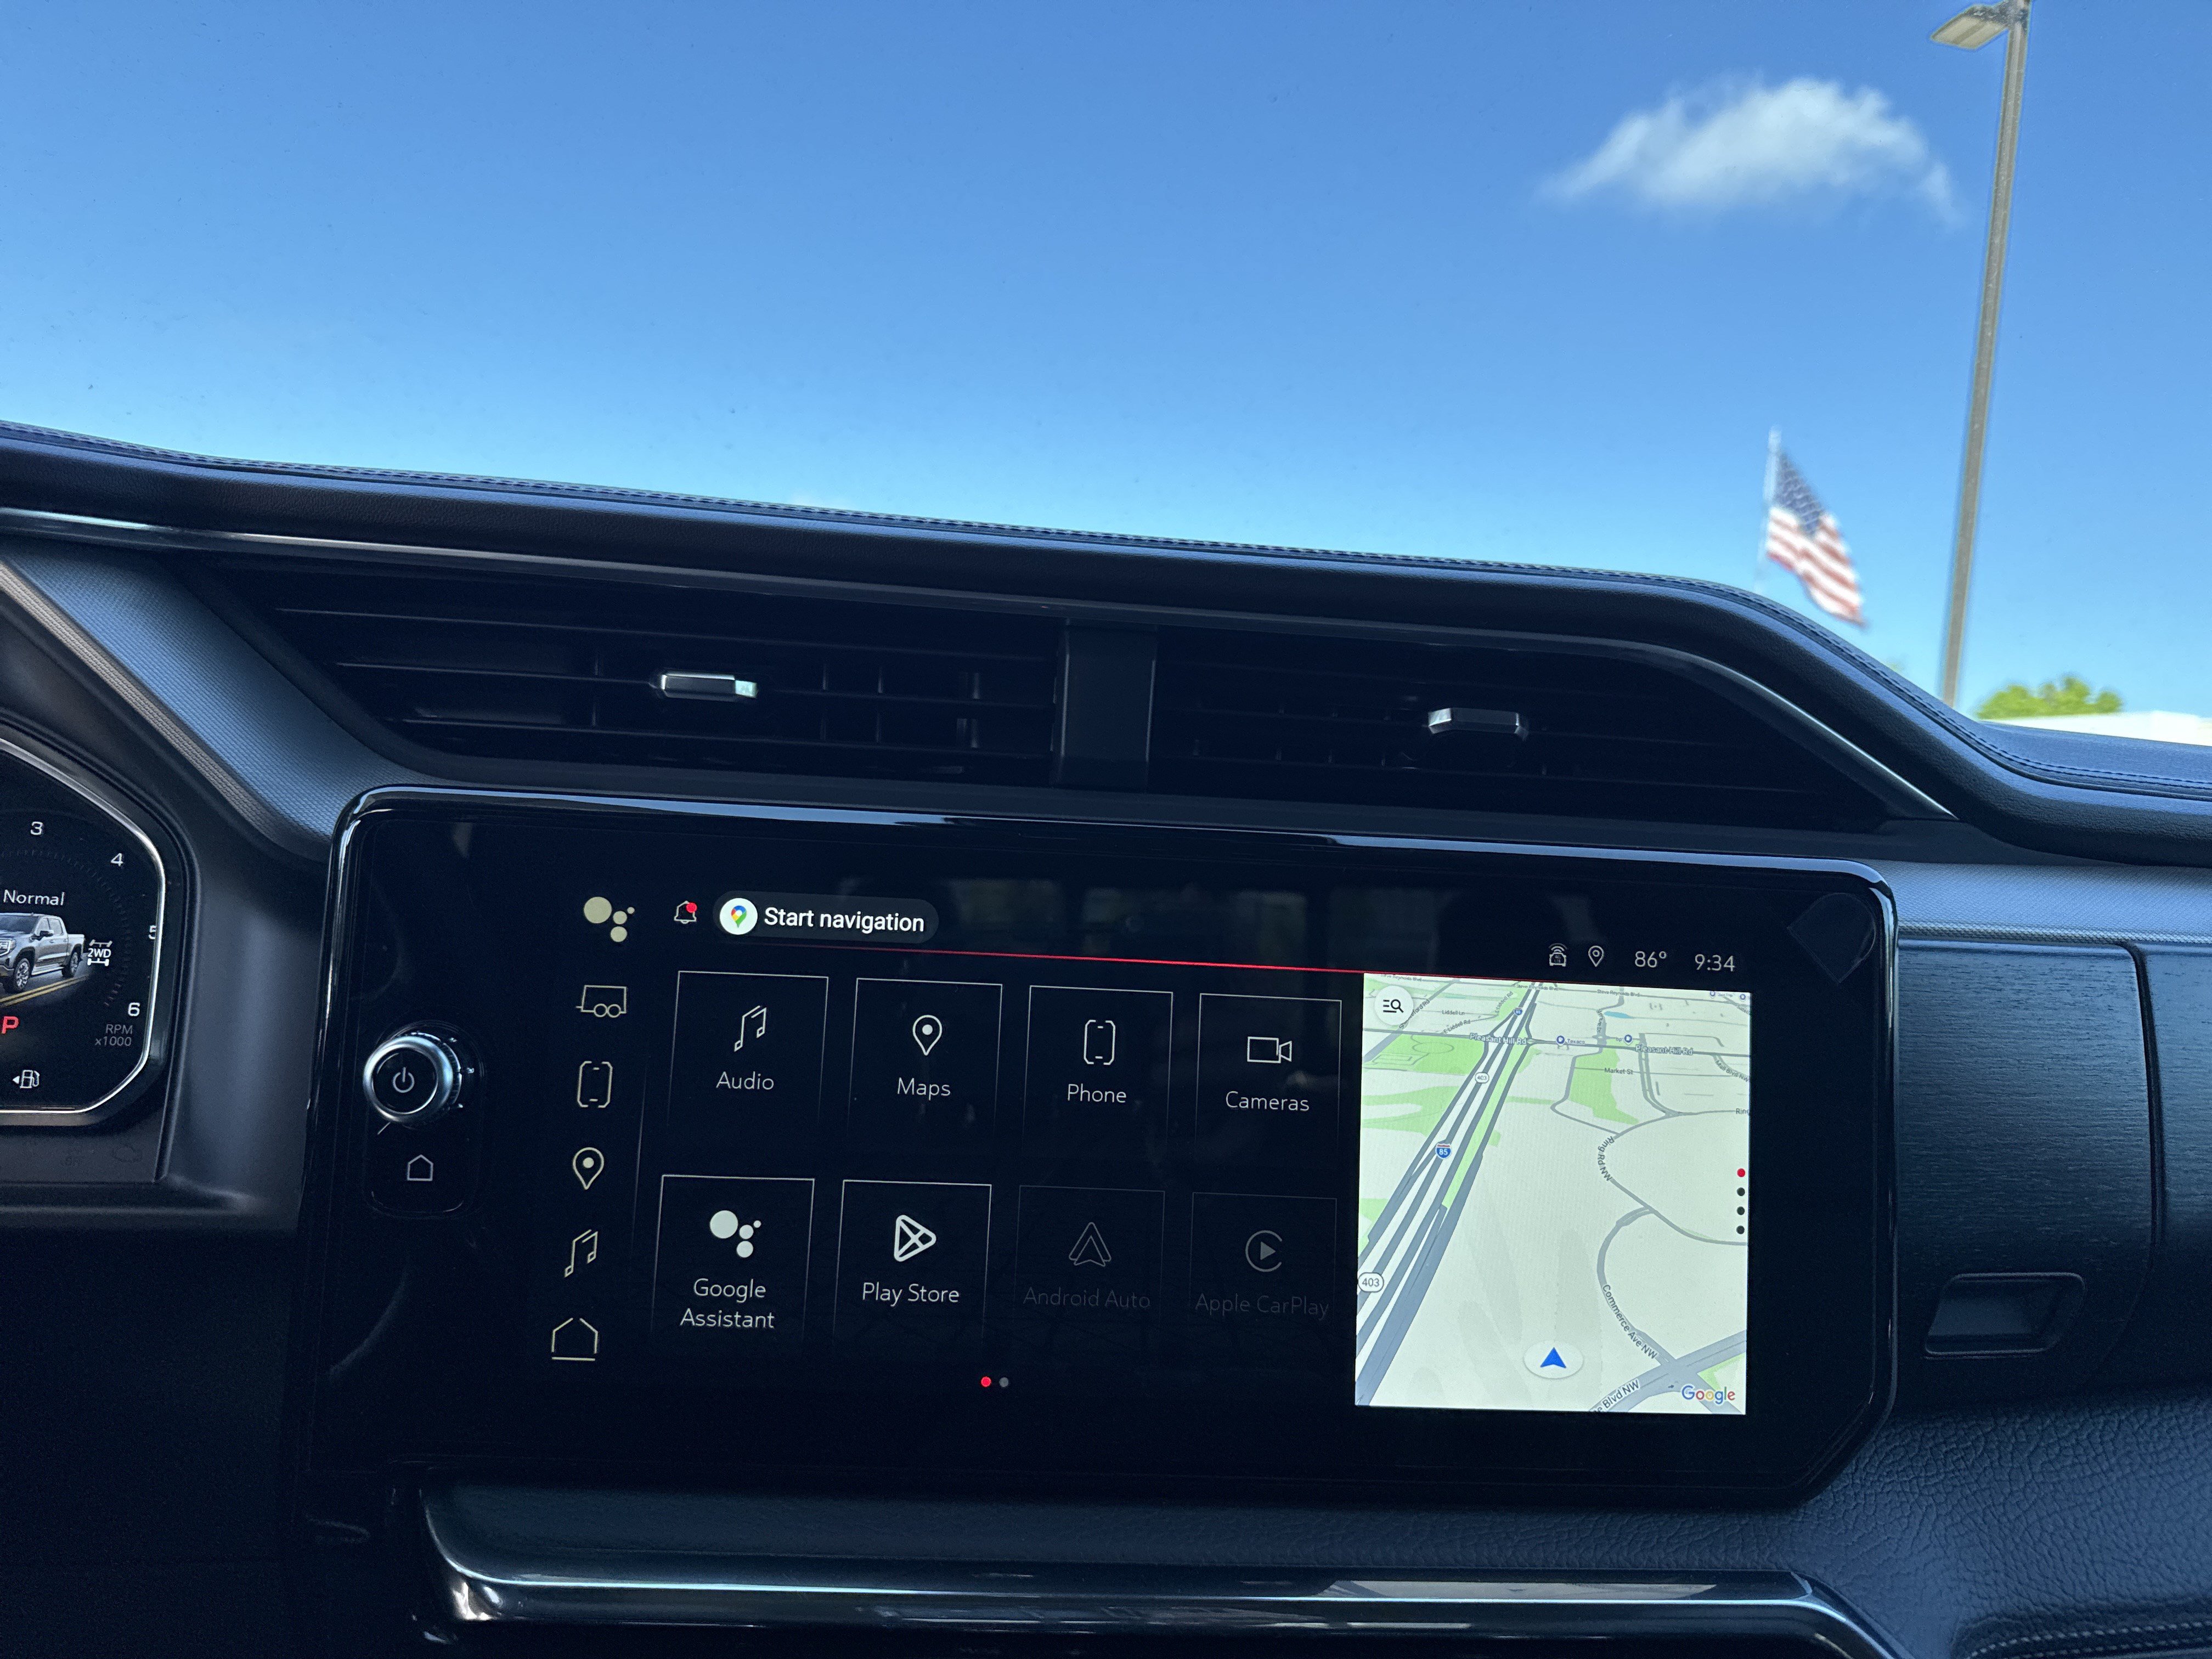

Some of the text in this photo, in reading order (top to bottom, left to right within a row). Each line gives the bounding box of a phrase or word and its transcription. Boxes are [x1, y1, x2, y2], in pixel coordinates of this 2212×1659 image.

[30, 821, 44, 836] 3
[110, 853, 123, 866] 4
[3, 889, 65, 906] Normal
[764, 907, 924, 934] Start navigation
[148, 925, 157, 940] 5
[87, 947, 112, 958] 2WD
[1634, 951, 1667, 968] 86°
[1695, 953, 1735, 972] 9:34
[127, 1002, 140, 1017] 6
[2, 1016, 19, 1034] P
[104, 1024, 133, 1035] RPM
[1448, 1022, 1463, 1032] Liddell
[94, 1035, 132, 1047] x1000
[1470, 1032, 1501, 1043] Pleasant
[1635, 1045, 1668, 1054] Pleasant
[1716, 1060, 1726, 1071] Mall
[1726, 1067, 1739, 1077] Blvd
[716, 1071, 774, 1090] Audio
[897, 1077, 951, 1101] Maps
[1068, 1083, 1127, 1103] Phone
[1226, 1091, 1310, 1111] Cameras
[1597, 1136, 1615, 1181] Ring Rd NW
[693, 1279, 766, 1303] Google
[1362, 1278, 1380, 1287] 403
[862, 1282, 960, 1307] Play Store
[1023, 1286, 1150, 1308] Android Auto
[1195, 1293, 1329, 1320] Apple CarPlay
[680, 1308, 775, 1328] Assistant
[1602, 1284, 1658, 1359] Commerce Ave NW
[1602, 1380, 1639, 1409] Blvd NW
[1681, 1385, 1735, 1404] Google
